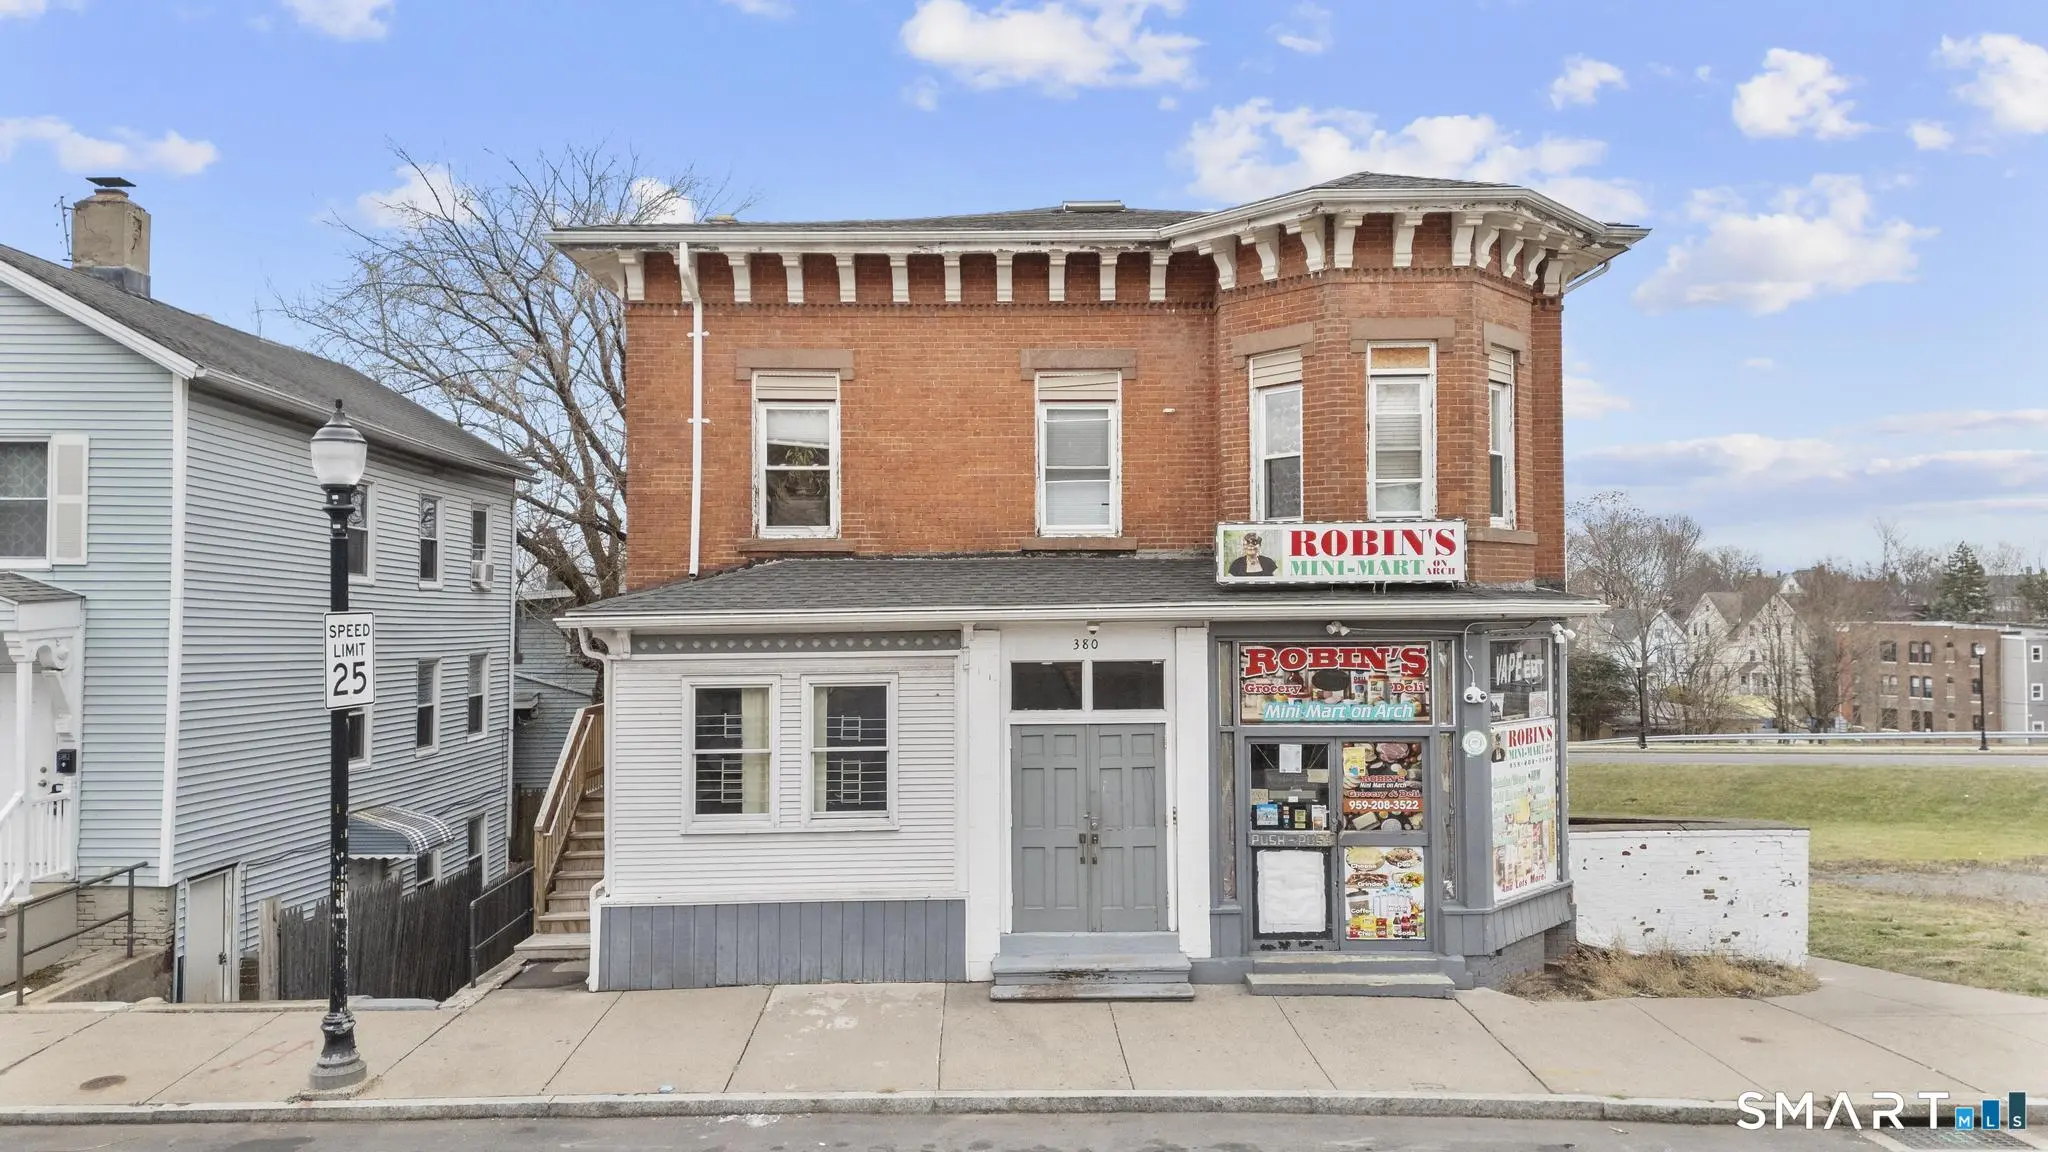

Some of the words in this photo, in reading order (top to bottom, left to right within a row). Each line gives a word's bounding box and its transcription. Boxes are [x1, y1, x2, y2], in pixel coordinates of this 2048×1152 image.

[1288, 528, 1457, 557] ROBIN'S
[1289, 559, 1425, 576] MINI-MART
[1426, 567, 1456, 575] ARCH
[1432, 559, 1448, 567] ON
[329, 623, 371, 639] SPEED
[333, 642, 366, 658] LIMIT
[1072, 638, 1099, 650] 380
[1244, 646, 1428, 677] ROBIN'S
[1496, 651, 1524, 686] VAPE
[1523, 658, 1545, 679] EBT
[332, 661, 367, 697] 25
[1244, 683, 1302, 695] Grocery
[1391, 682, 1426, 693] Deli
[1351, 706, 1372, 719] on
[1374, 703, 1413, 718] Arch
[1348, 800, 1419, 810] 959-208-3522
[1251, 834, 1285, 846] PUSH
